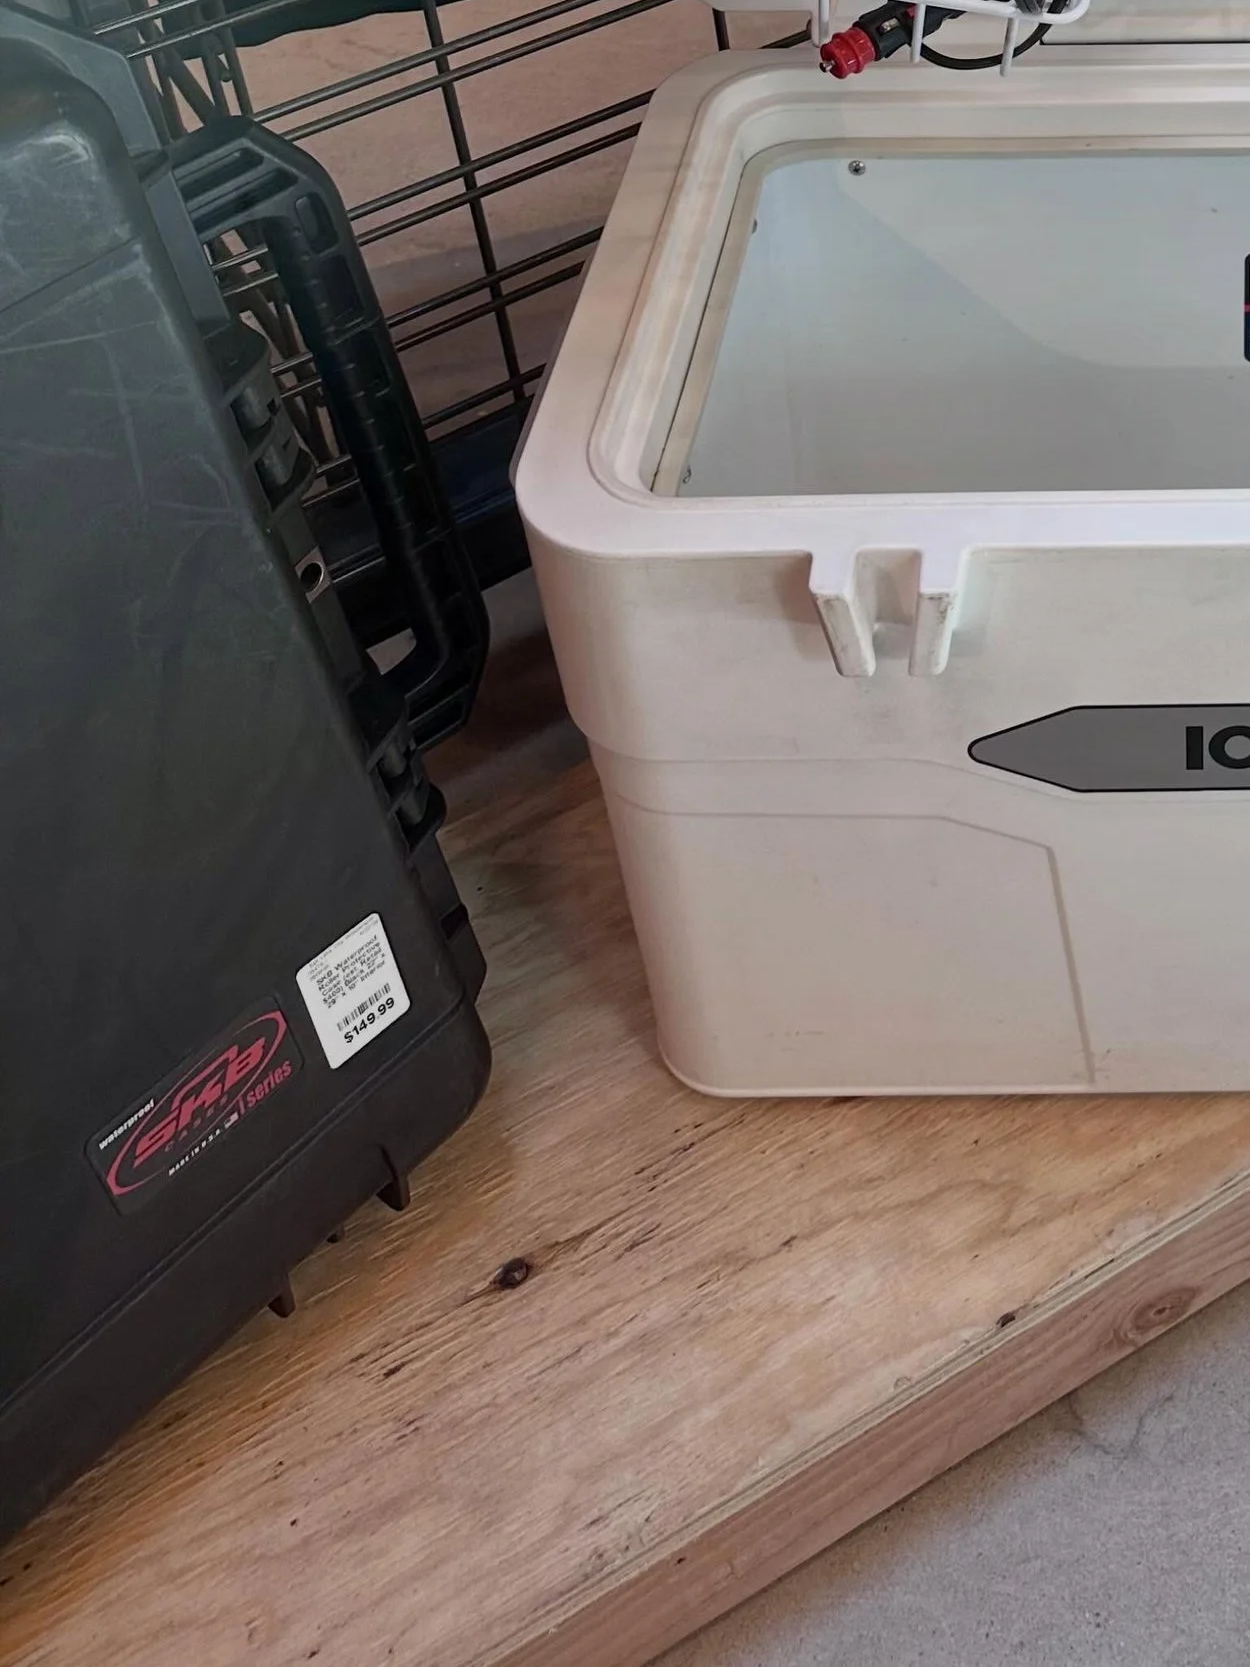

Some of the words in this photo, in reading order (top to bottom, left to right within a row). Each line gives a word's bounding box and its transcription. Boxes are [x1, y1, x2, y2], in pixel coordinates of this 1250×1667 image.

[334, 934, 377, 972] Waterproof
[342, 941, 381, 973] Protective
[344, 997, 395, 1043] $149.99
[132, 1037, 266, 1169] SKB
[247, 1060, 293, 1108] series
[98, 1098, 155, 1150] waterproof
